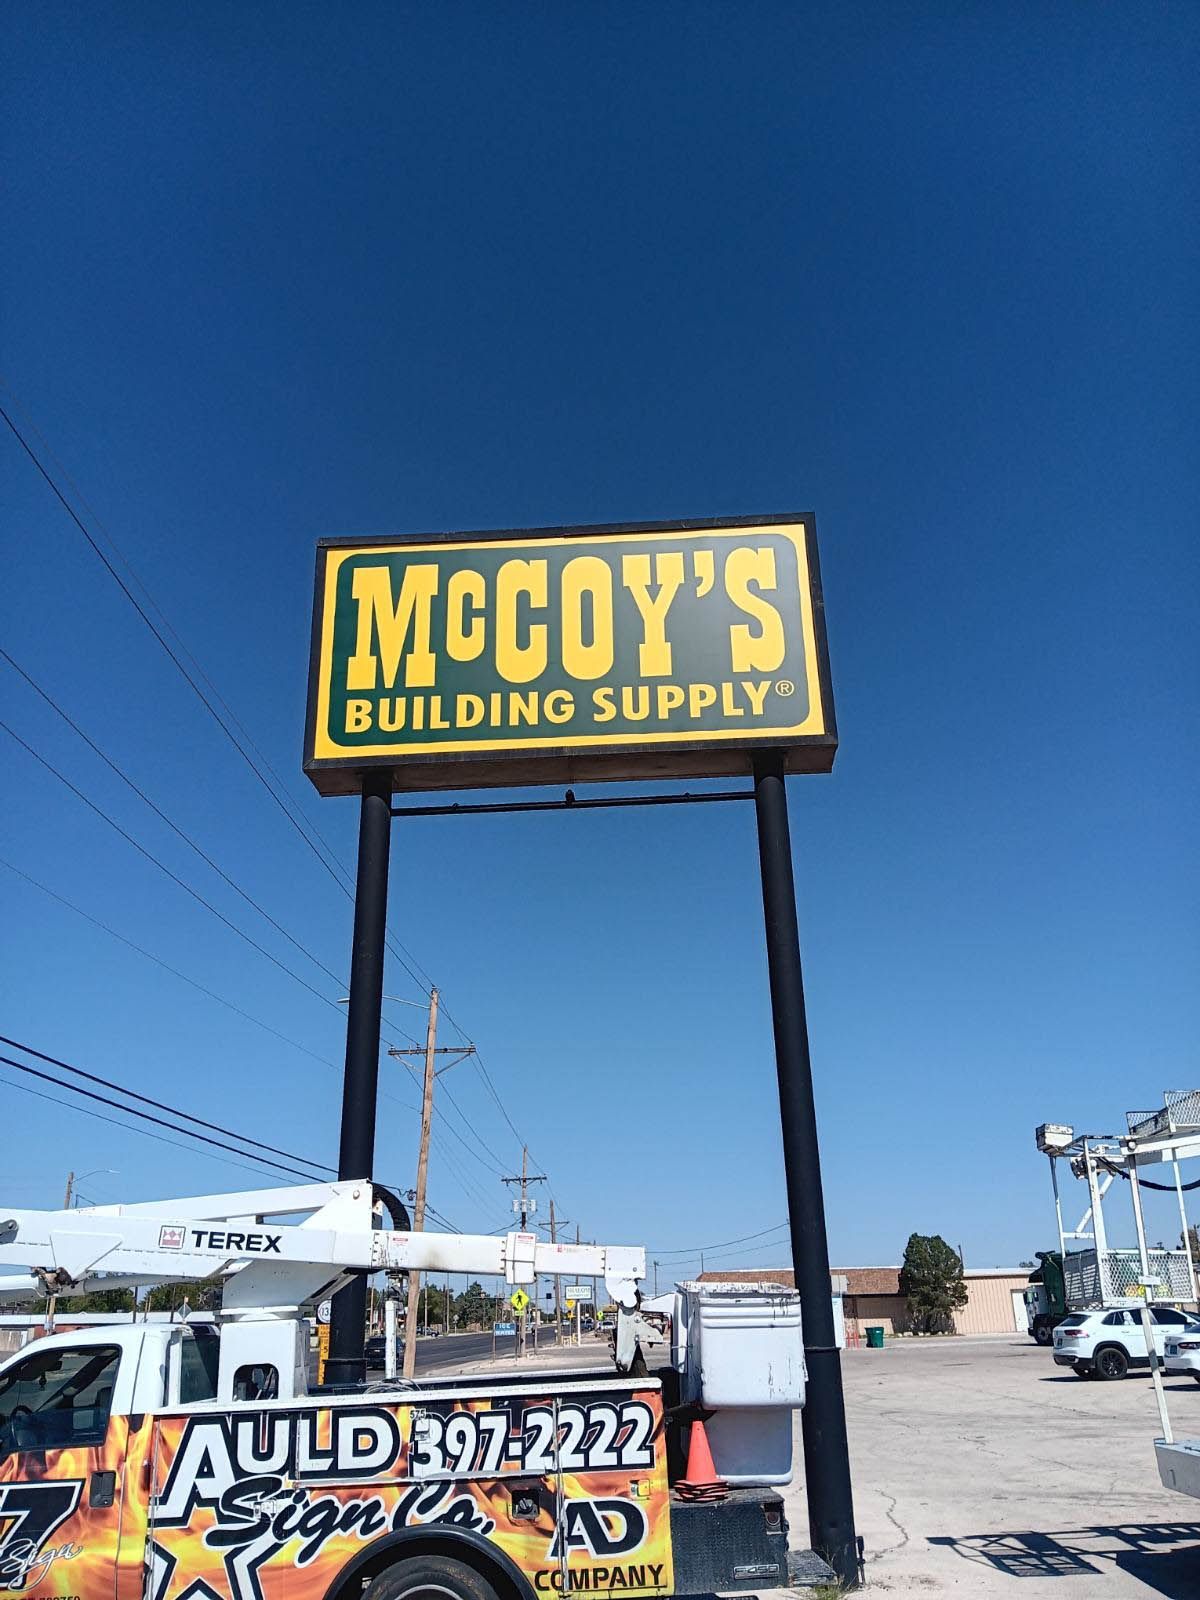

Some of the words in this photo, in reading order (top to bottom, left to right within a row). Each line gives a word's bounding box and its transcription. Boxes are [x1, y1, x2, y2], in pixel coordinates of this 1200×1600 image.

[344, 689, 575, 734] BUILDING
[191, 1230, 283, 1254] TEREX
[410, 1409, 427, 1420] 575
[410, 1402, 655, 1478] 397-2222
[149, 1409, 398, 1525] AULD
[204, 1475, 386, 1566] Sign
[547, 1499, 647, 1559] AD
[534, 1564, 664, 1592] COMPANY
